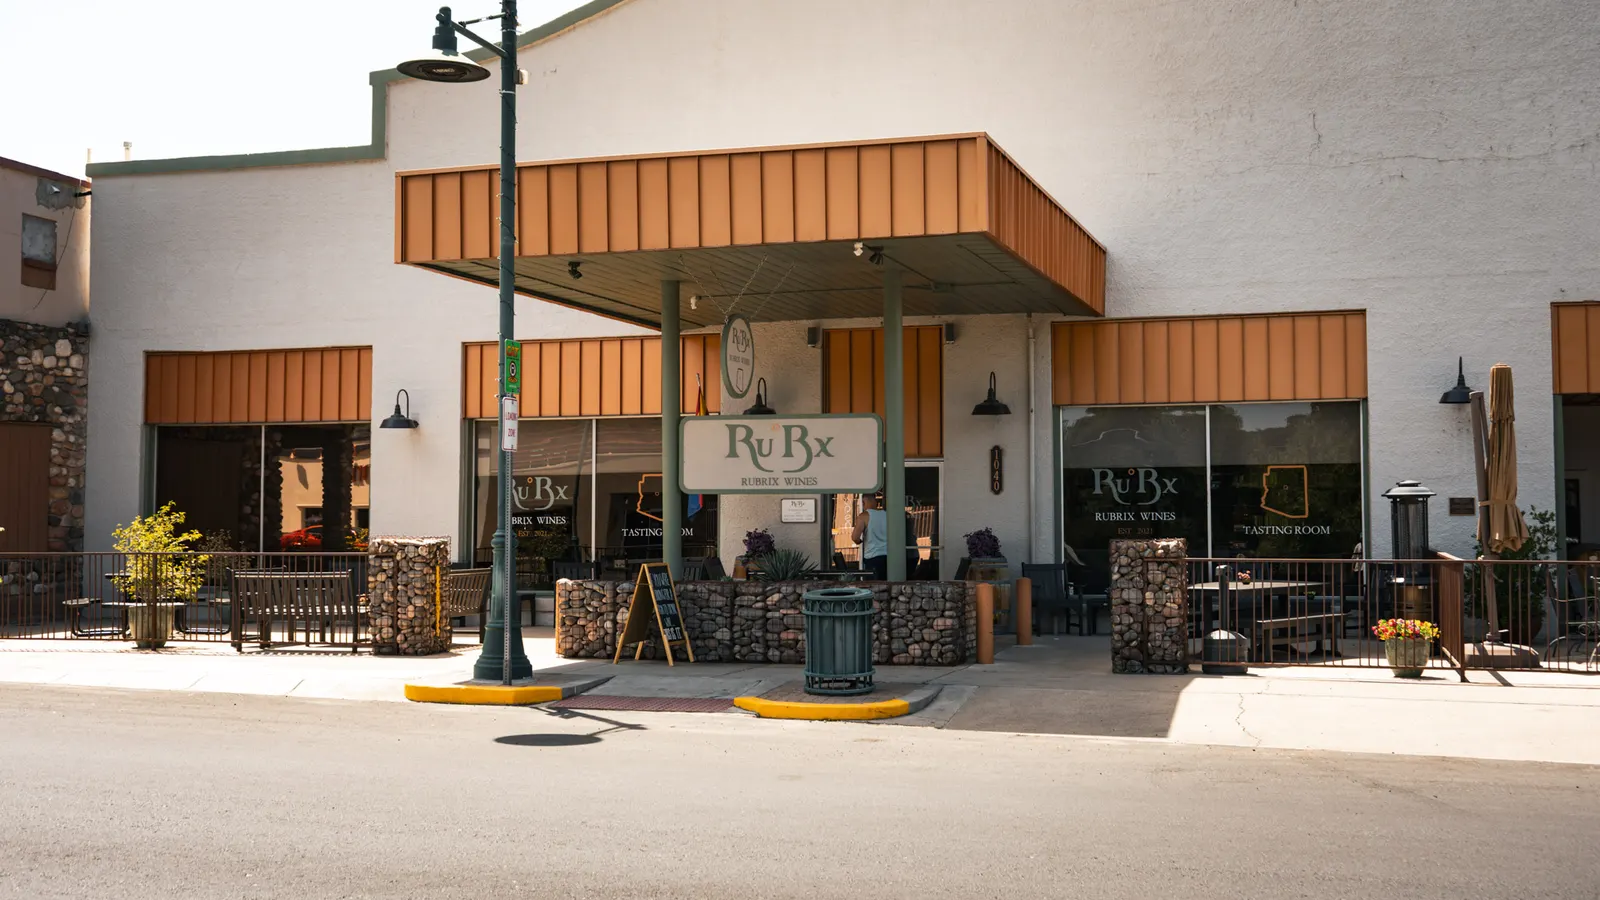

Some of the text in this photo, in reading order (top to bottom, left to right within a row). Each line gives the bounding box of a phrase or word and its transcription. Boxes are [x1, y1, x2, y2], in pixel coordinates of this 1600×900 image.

[741, 477, 818, 486] RUBRIX WINES
[511, 516, 567, 525] BRIX WINES
[1095, 512, 1176, 521] RUBRIX WINES
[621, 527, 663, 537] TASTING
[1137, 527, 1153, 535] 2021
[1242, 525, 1330, 535] TASTING ROOM
